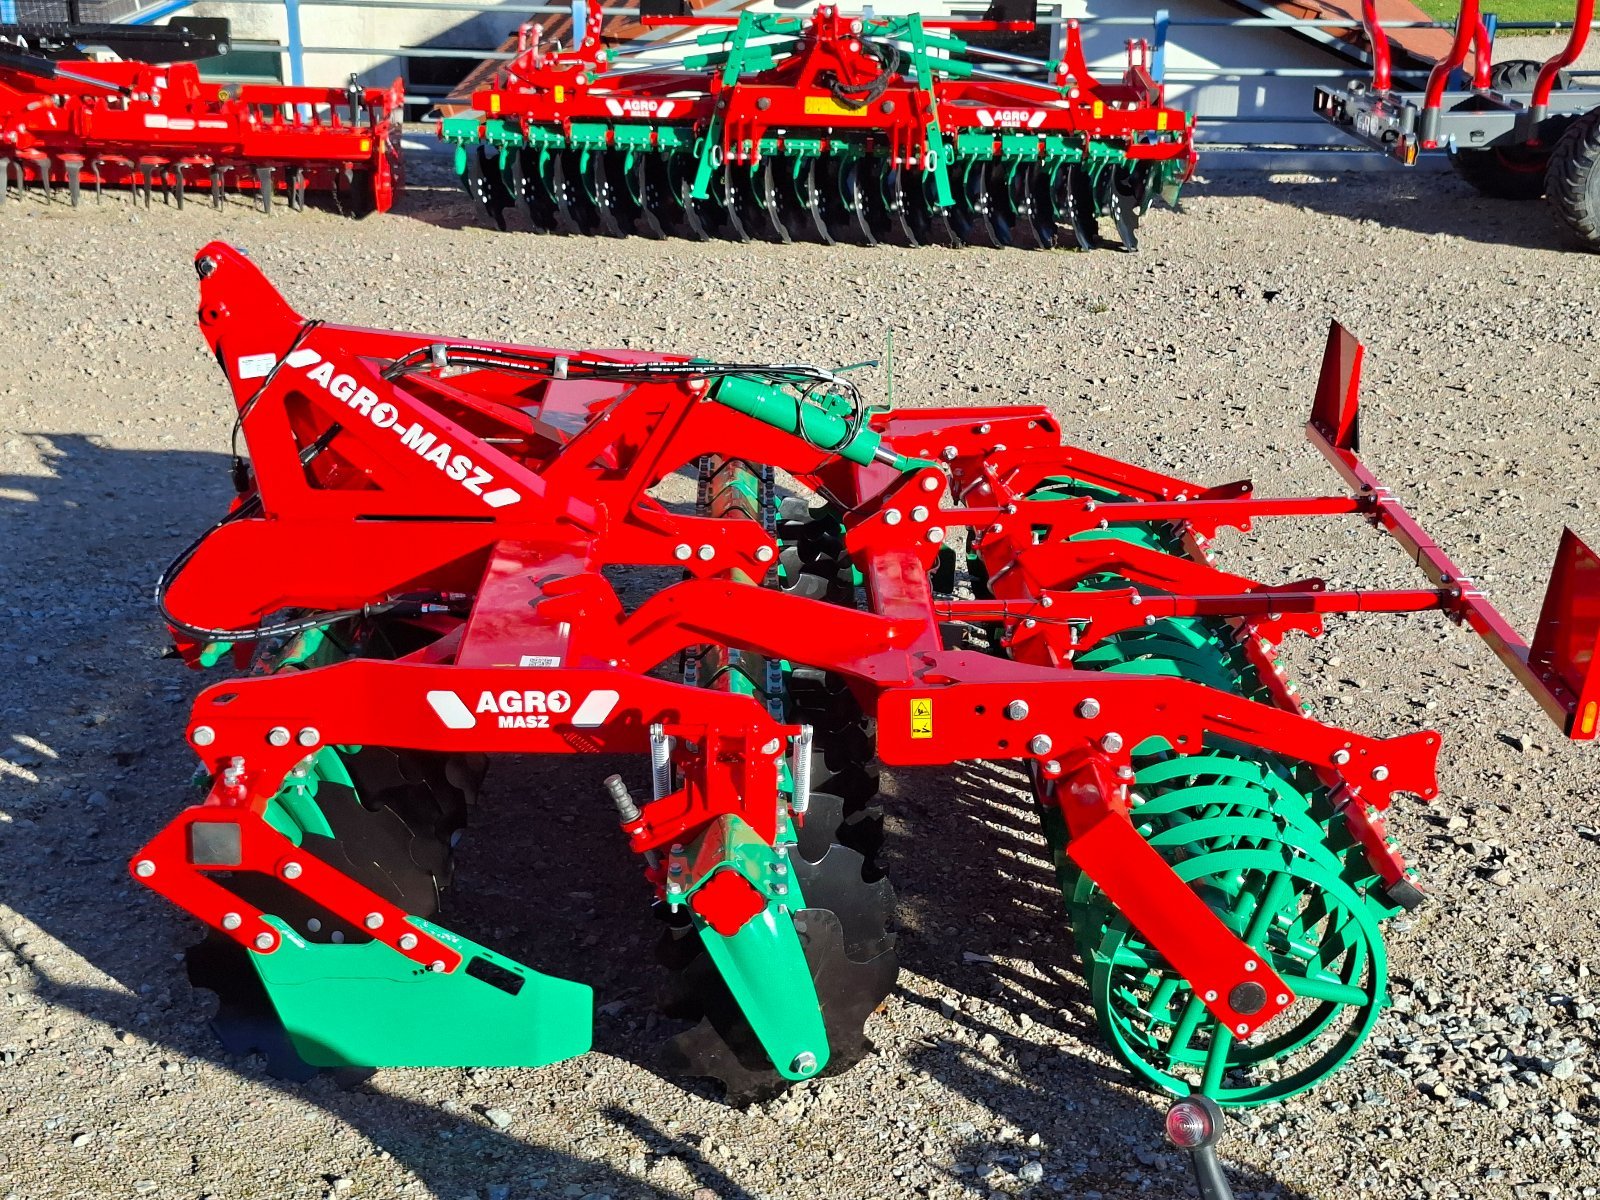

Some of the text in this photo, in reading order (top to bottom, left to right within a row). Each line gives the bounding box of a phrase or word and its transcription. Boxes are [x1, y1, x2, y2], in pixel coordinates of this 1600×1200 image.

[306, 361, 494, 496] AGRO-MASZ
[476, 690, 571, 713] AGRO
[498, 715, 550, 728] MASZ
